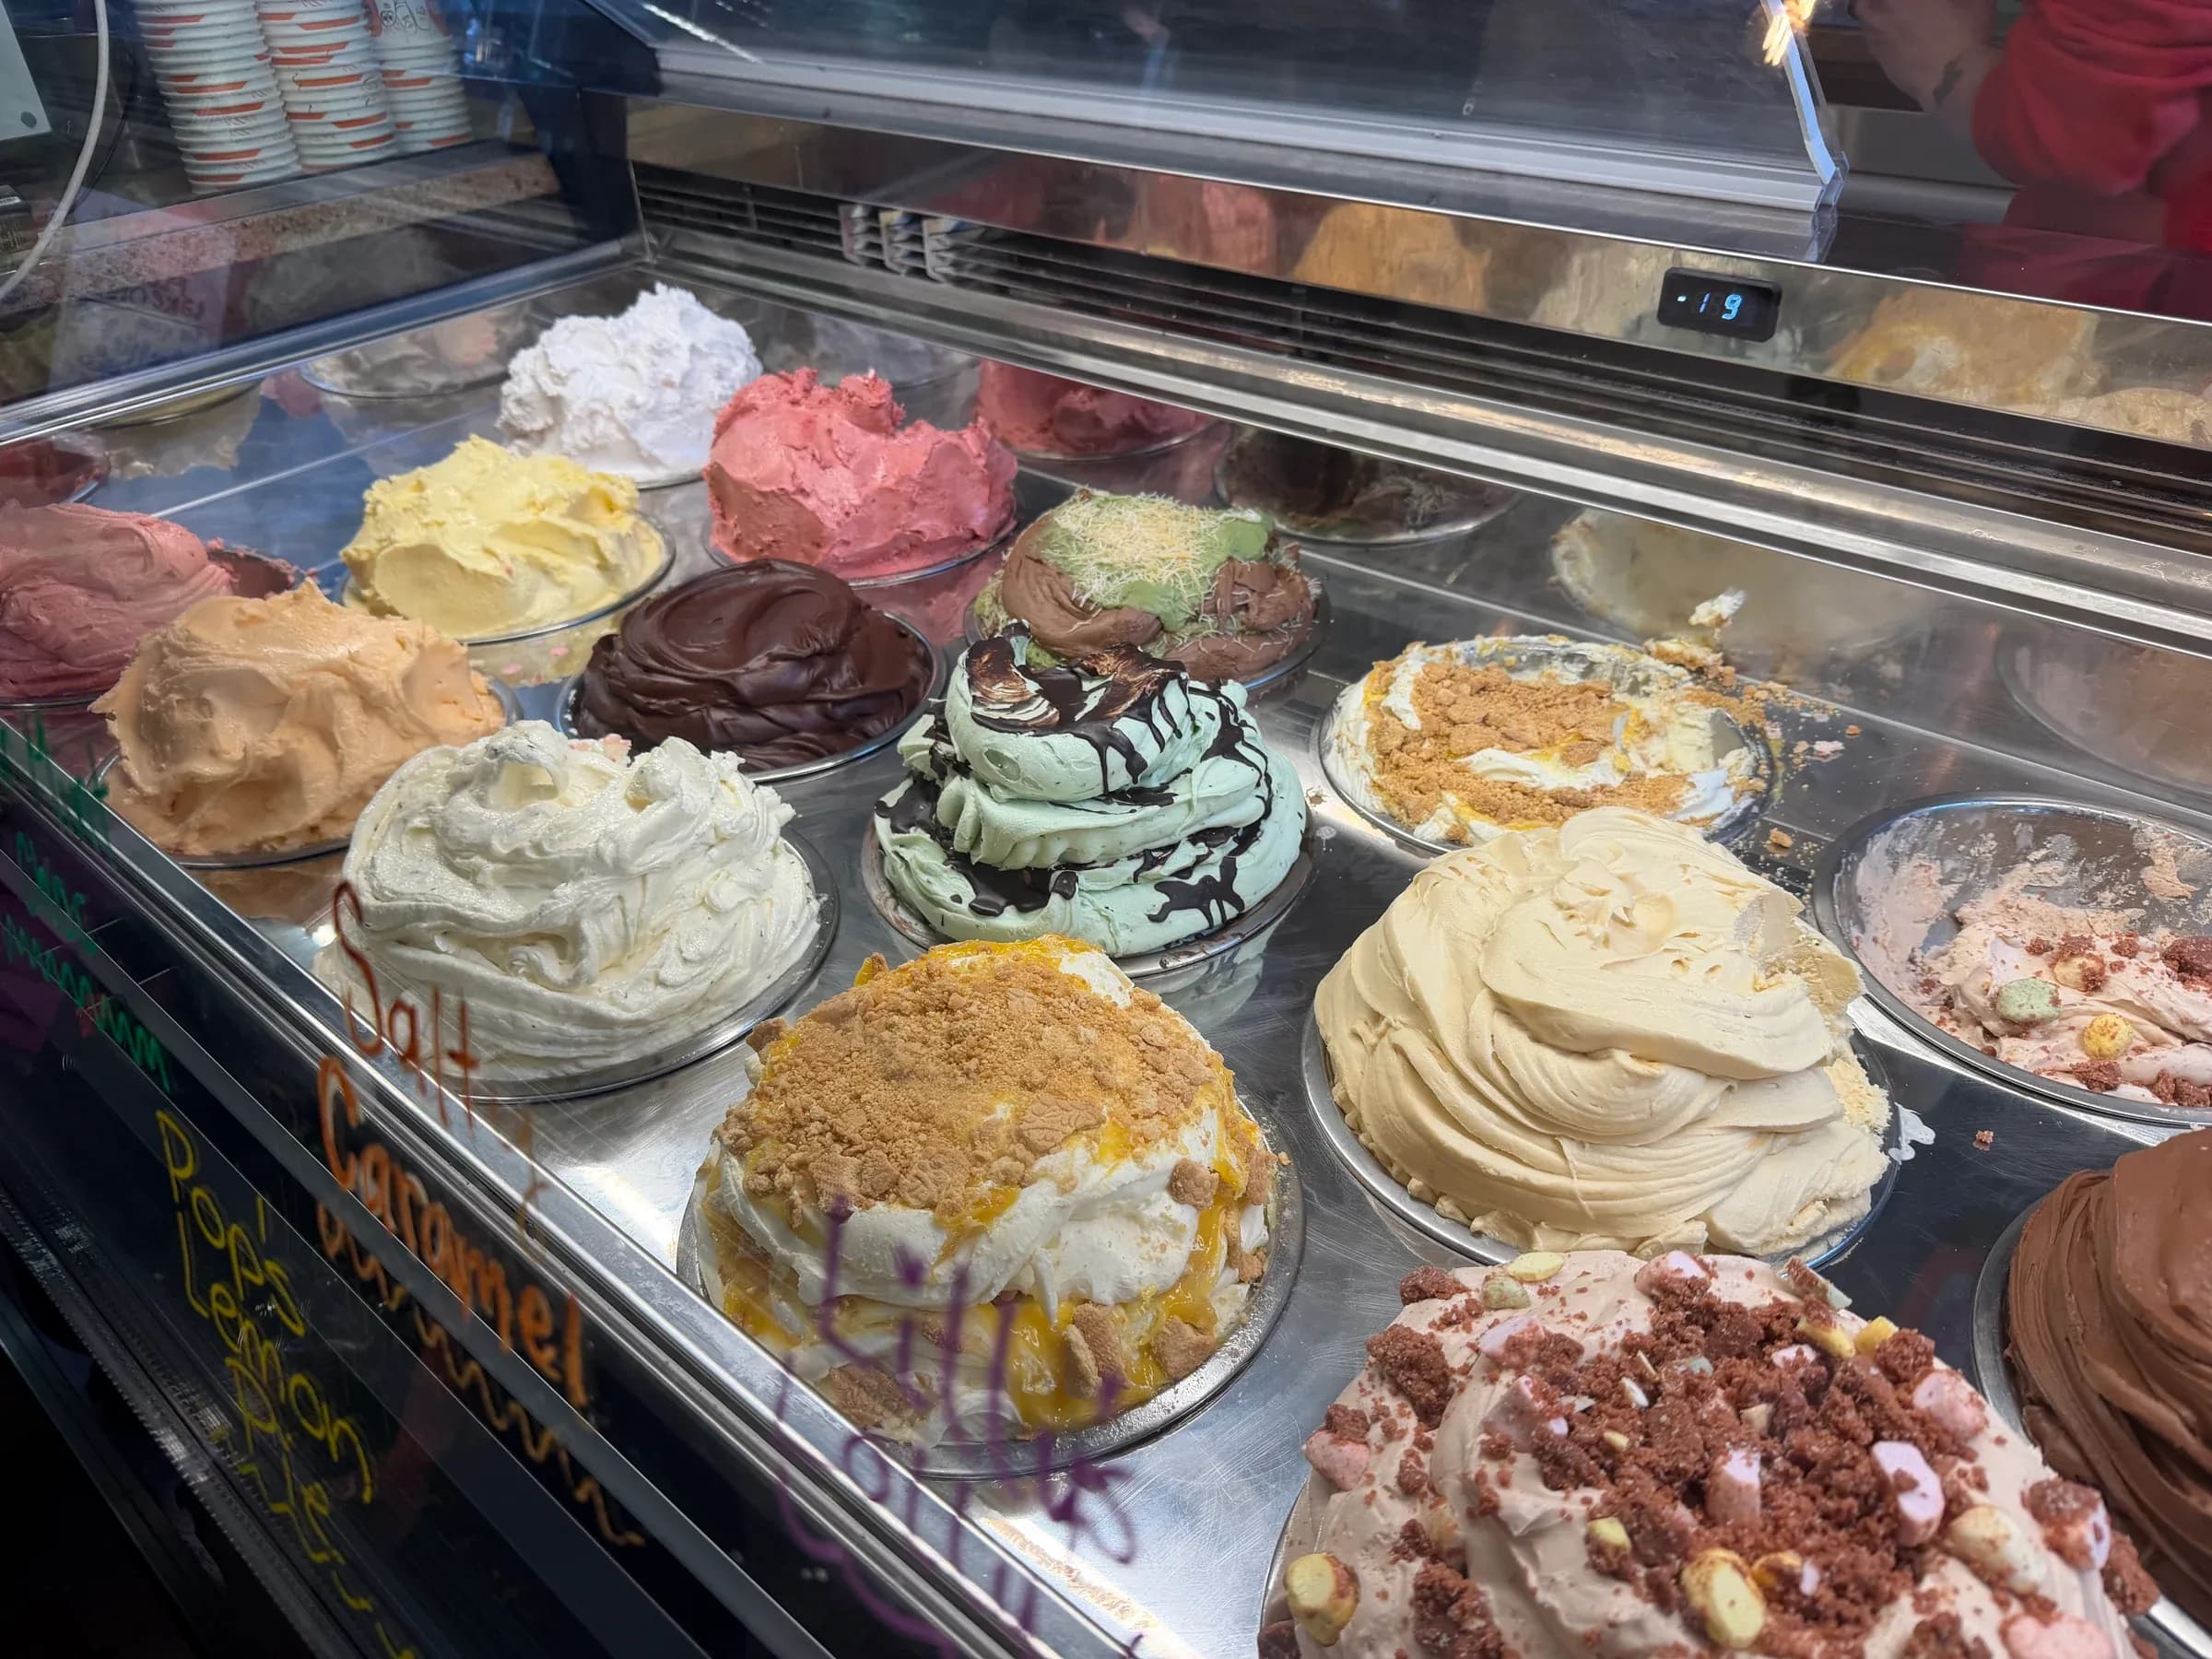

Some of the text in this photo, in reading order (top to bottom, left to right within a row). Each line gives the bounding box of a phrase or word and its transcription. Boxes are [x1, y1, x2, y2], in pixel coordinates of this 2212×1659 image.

[156, 1109, 306, 1336] Pop's
[177, 1209, 373, 1505] Lemon
[316, 1054, 592, 1410] Caramel
